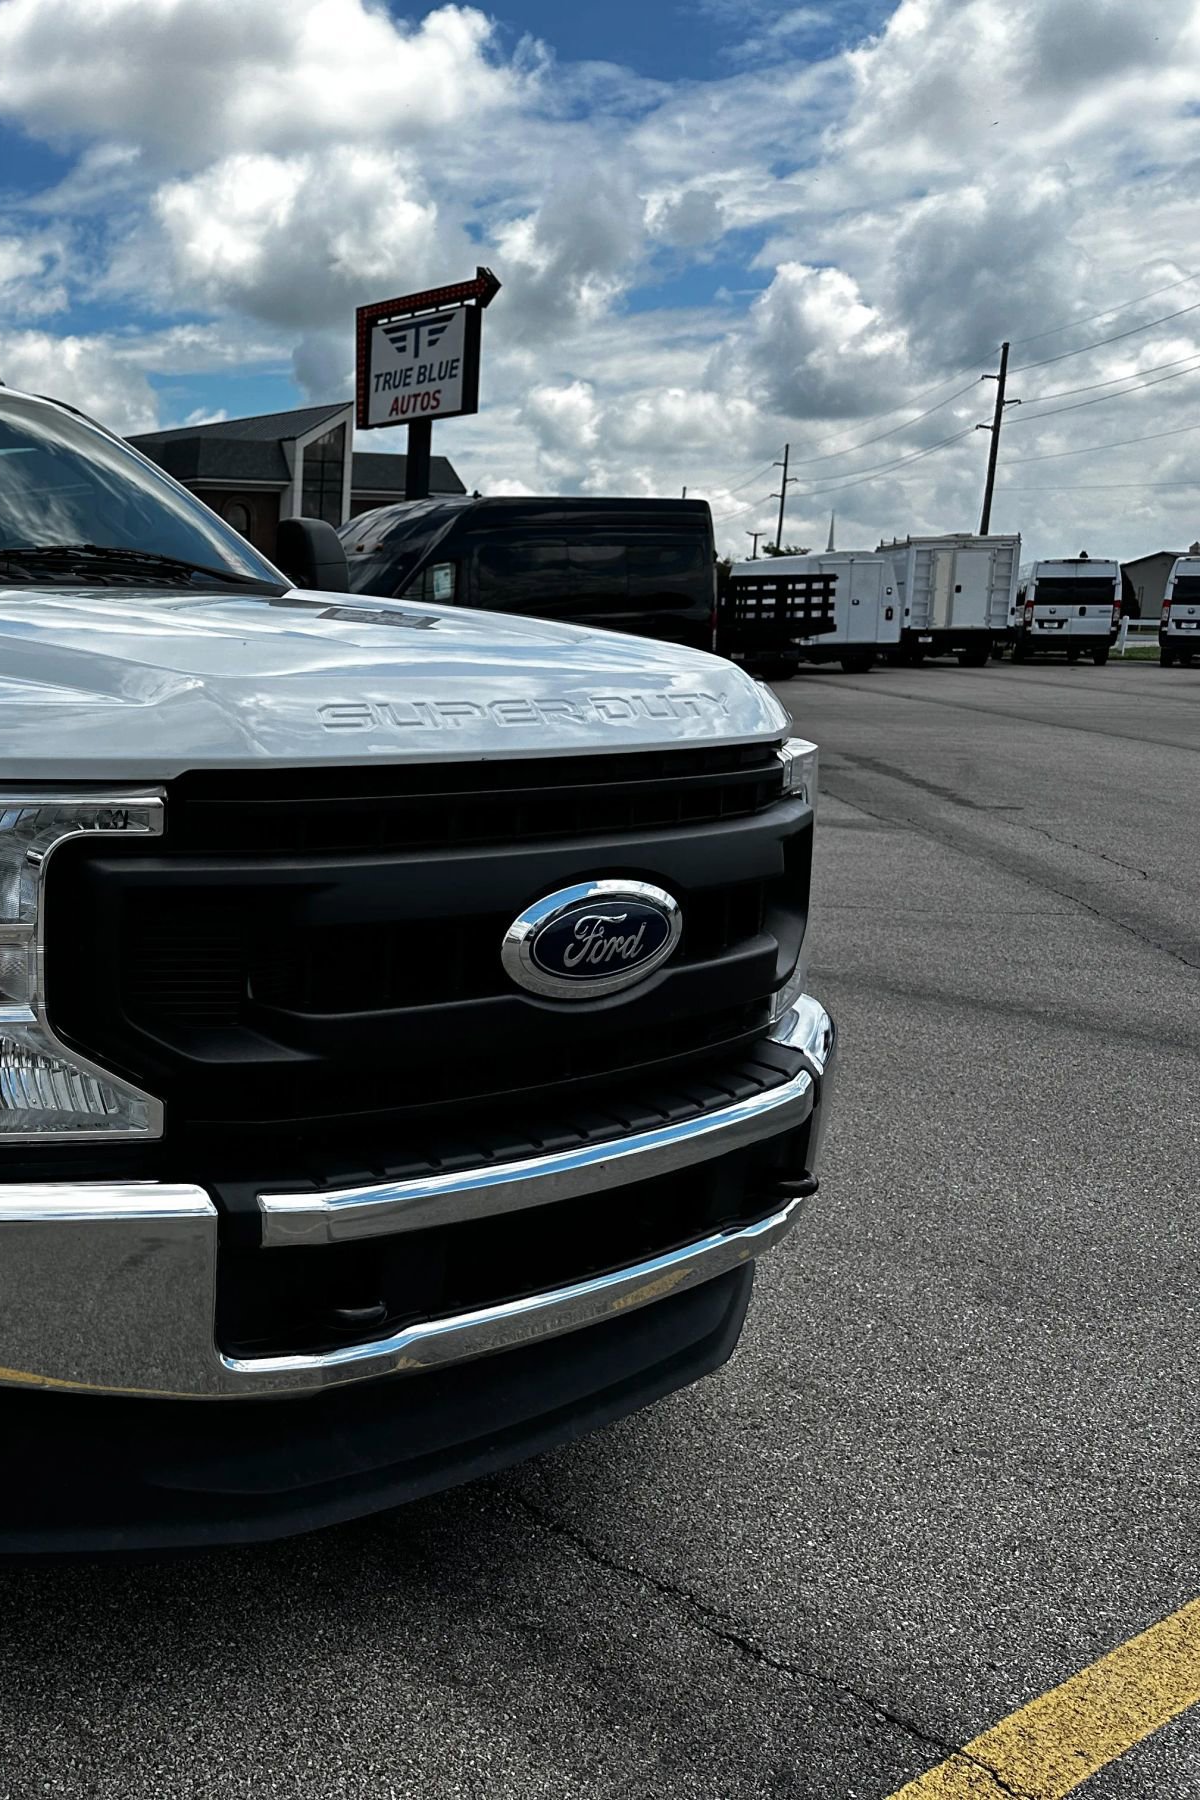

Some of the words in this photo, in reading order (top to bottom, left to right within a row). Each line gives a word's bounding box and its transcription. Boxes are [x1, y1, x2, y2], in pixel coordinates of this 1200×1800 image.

[373, 367, 414, 393] TRUE
[416, 358, 460, 385] BLUE
[388, 389, 441, 417] AUTOS
[315, 699, 588, 733] SUPER
[586, 691, 731, 728] DUTY
[563, 913, 647, 968] Ford
